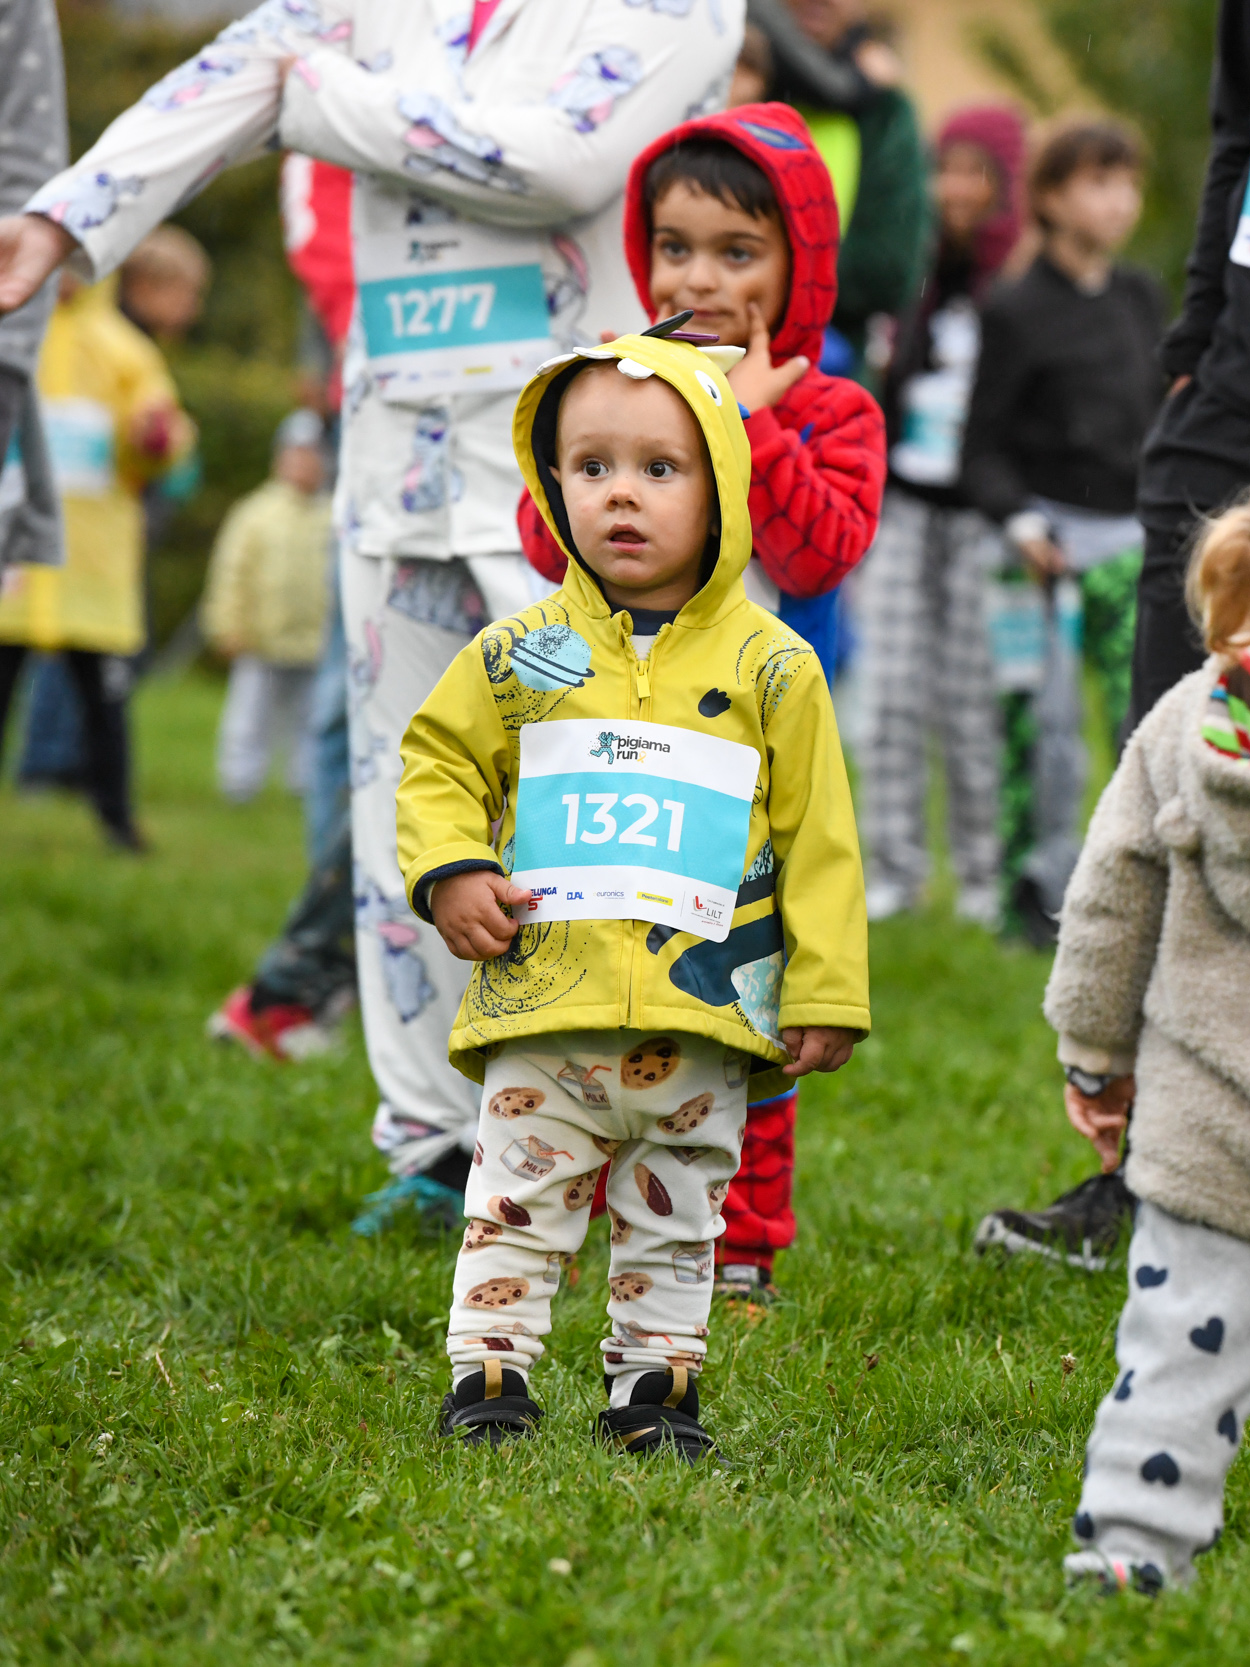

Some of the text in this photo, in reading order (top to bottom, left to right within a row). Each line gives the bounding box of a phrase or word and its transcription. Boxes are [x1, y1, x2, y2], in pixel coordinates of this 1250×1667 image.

[385, 282, 496, 338] 1277
[617, 736, 671, 753] pigiama
[616, 750, 638, 760] run
[562, 793, 685, 852] 1321
[530, 886, 557, 897] ELUNGA
[706, 907, 723, 920] LILT
[585, 1091, 607, 1103] MILK
[522, 1160, 548, 1176] MILK
